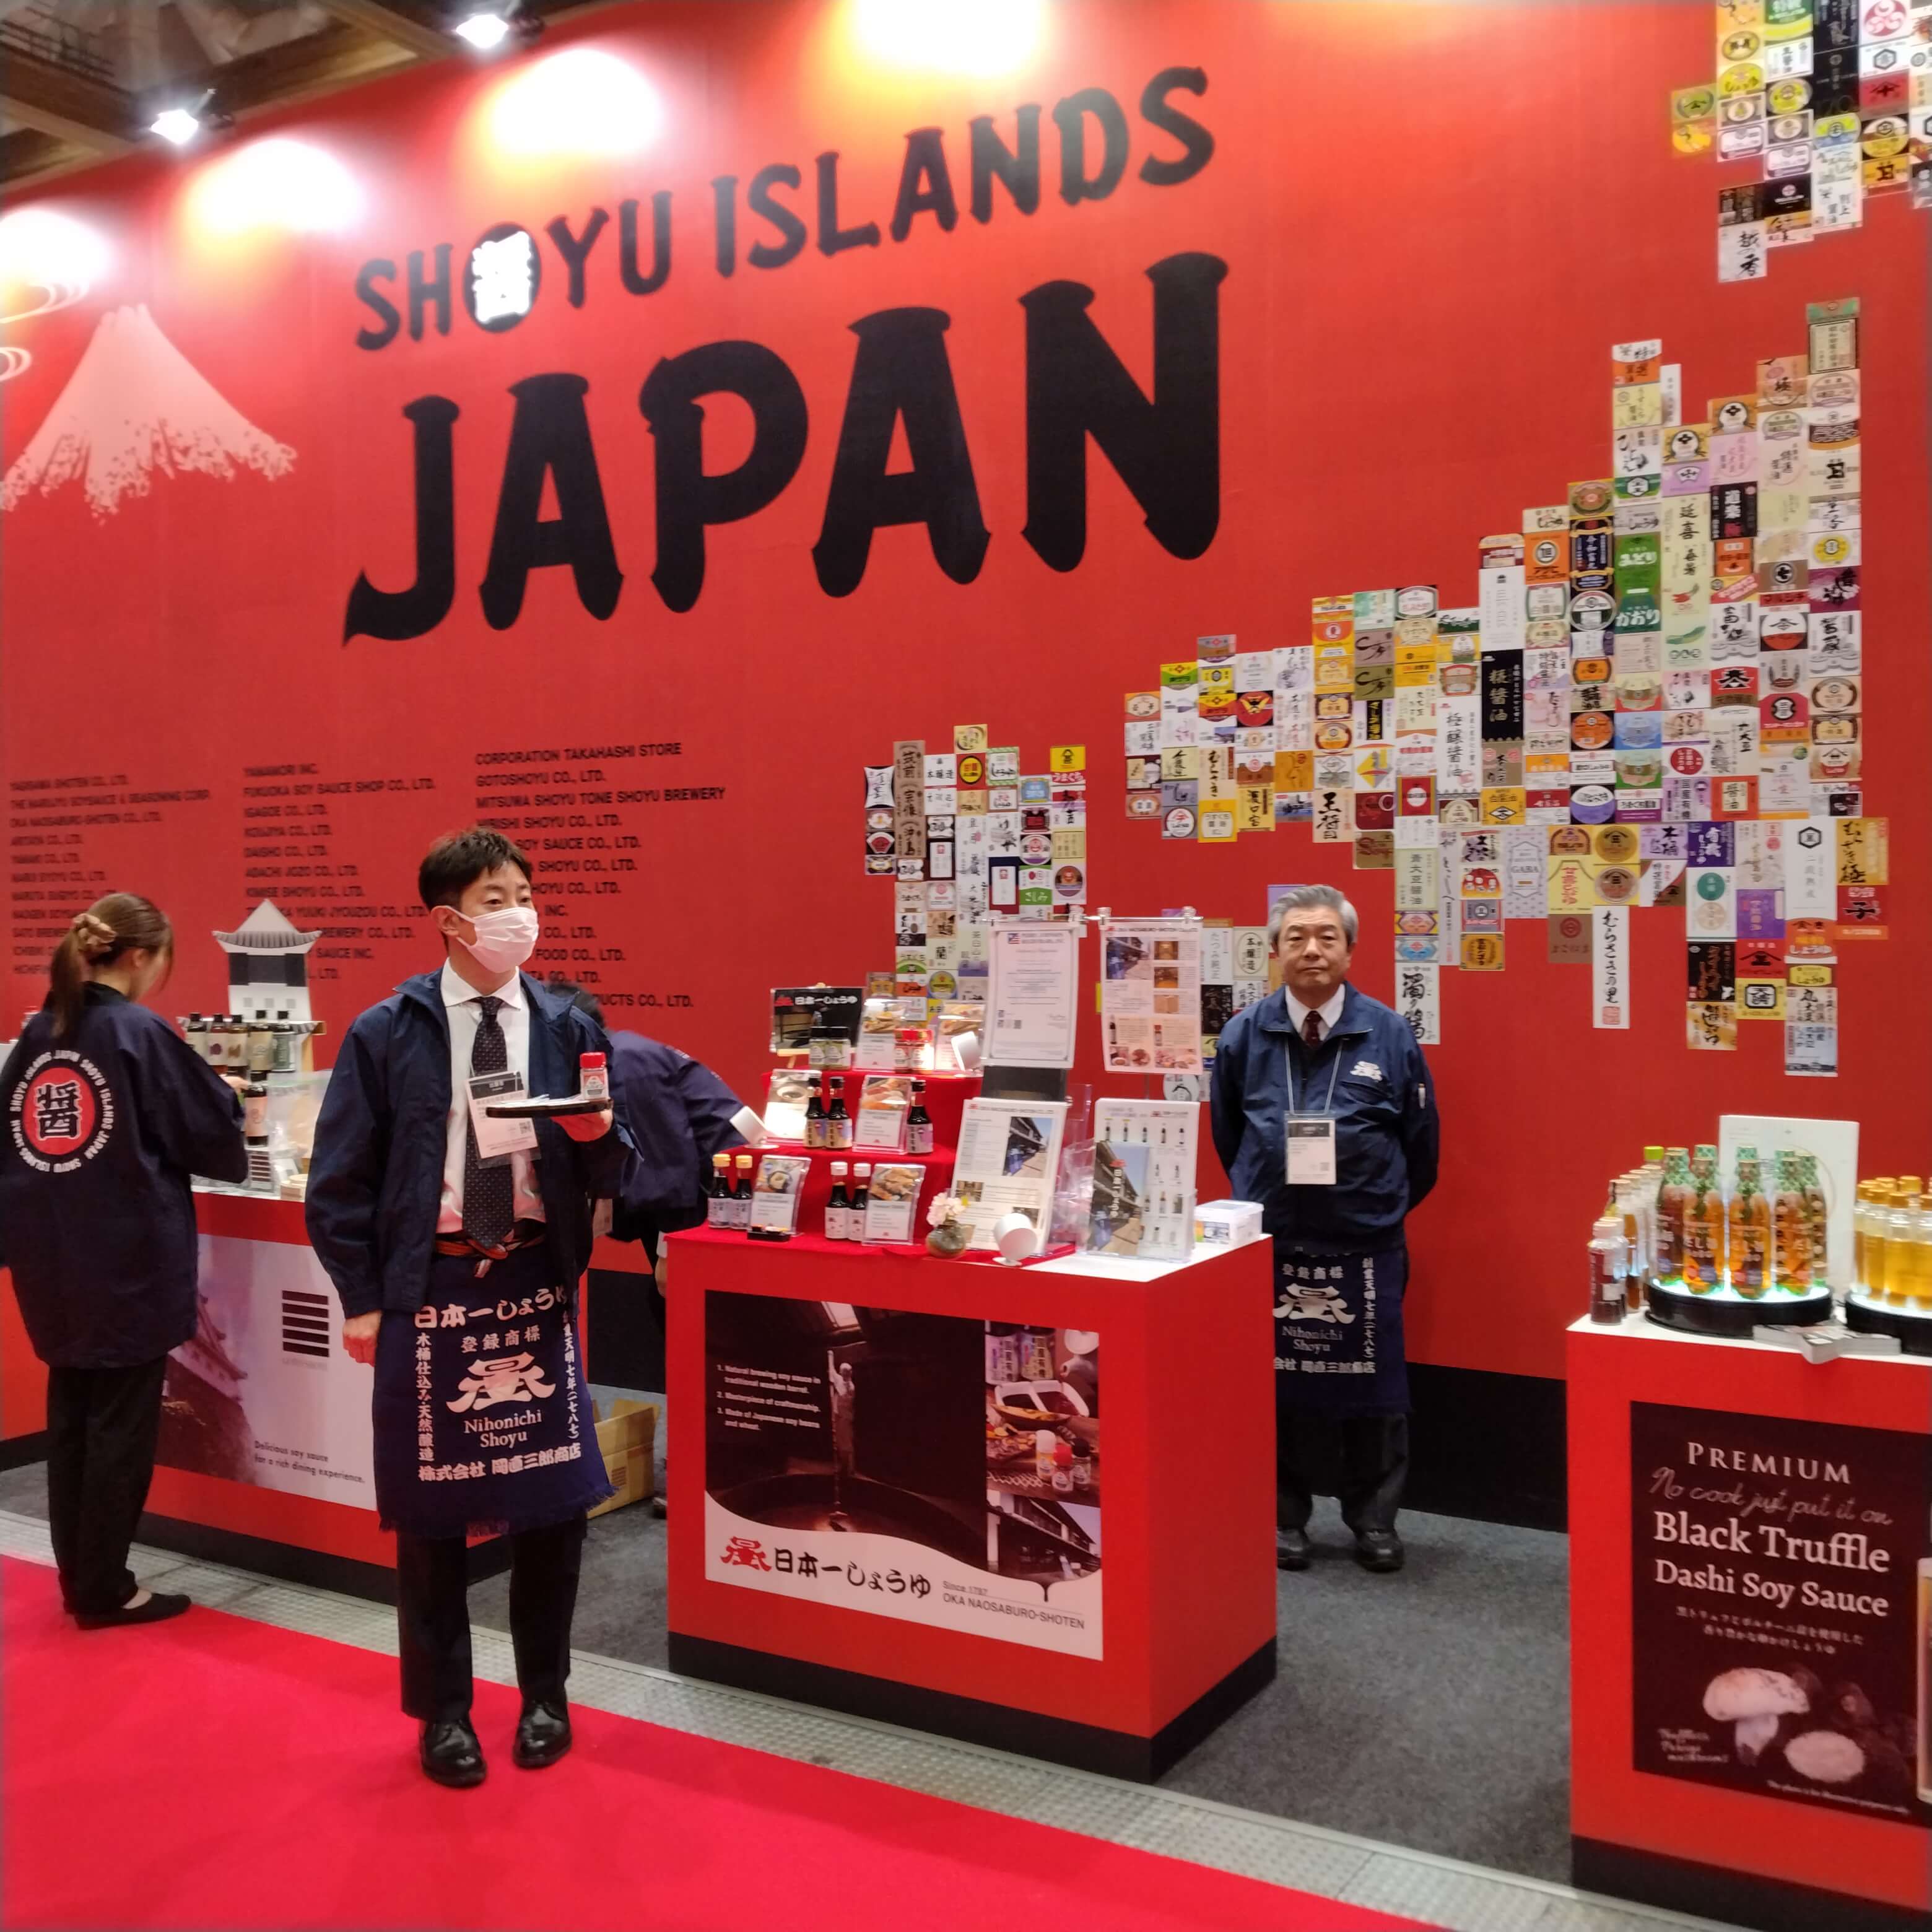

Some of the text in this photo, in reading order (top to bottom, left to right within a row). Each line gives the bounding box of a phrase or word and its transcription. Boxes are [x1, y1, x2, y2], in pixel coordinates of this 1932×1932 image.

[355, 191, 672, 350] SHOYU
[711, 66, 1215, 277] ISLANDS
[342, 251, 1229, 646] JAPAN
[1615, 609, 1660, 627] かおり
[475, 742, 681, 765] CORPORATION TAKAHASHI STORE
[294, 784, 312, 795] SOY
[317, 782, 351, 793] SAUCE
[356, 780, 385, 793] SHOP
[412, 778, 436, 790] LTD.
[476, 772, 549, 787] GOTOSHOYU
[580, 769, 606, 783] LTD.
[534, 792, 575, 806] SHOYU
[581, 791, 612, 804] TONE
[617, 789, 661, 803] SHOYU
[664, 786, 725, 802] BREWERY
[524, 816, 565, 829] SHOYU
[596, 814, 622, 827] LTD.
[516, 838, 538, 850] SOY
[544, 837, 583, 849] SAUCE
[616, 835, 641, 848] LTD.
[337, 865, 359, 876] LTD.
[538, 860, 580, 872] SHOYU
[611, 858, 637, 871] LTD.
[344, 886, 365, 897] LTD.
[531, 882, 564, 894] HOYU
[595, 881, 621, 894] LTD.
[406, 905, 429, 918] LTD.
[544, 904, 568, 916] INC.
[391, 927, 416, 938] LTD.
[571, 926, 597, 938] LTD.
[316, 947, 351, 959] SAUCE
[536, 949, 568, 960] FOOD
[600, 949, 625, 961] LTD.
[576, 971, 601, 983] LTD.
[667, 994, 694, 1007] LTD.
[99, 1088, 115, 1130] ISLANDS
[461, 1324, 541, 1354] 登録商標
[1282, 1325, 1343, 1341] Nihonichi
[1293, 1339, 1331, 1354] Shoyu
[464, 1409, 542, 1434] Nihonichi
[480, 1430, 528, 1448] Shoyu
[255, 1440, 329, 1463] Delicious soy sauce
[255, 1453, 266, 1463] for
[276, 1458, 290, 1468] rich
[292, 1461, 316, 1476] dining
[319, 1469, 365, 1484] experience.
[418, 1442, 582, 1482] 株式会社 岡直三郎商店
[1687, 1441, 1851, 1484] PREMIUM
[1649, 1466, 1894, 1526] No cook just put it on
[1653, 1510, 1891, 1573] Black Truffle
[774, 1547, 931, 1599] 日本一しょうゆ
[942, 1580, 967, 1593] Since
[1655, 1558, 1890, 1617] Dashi Soy Sauce
[942, 1592, 1086, 1630] OKA NAOSABURO-SHOTEN
